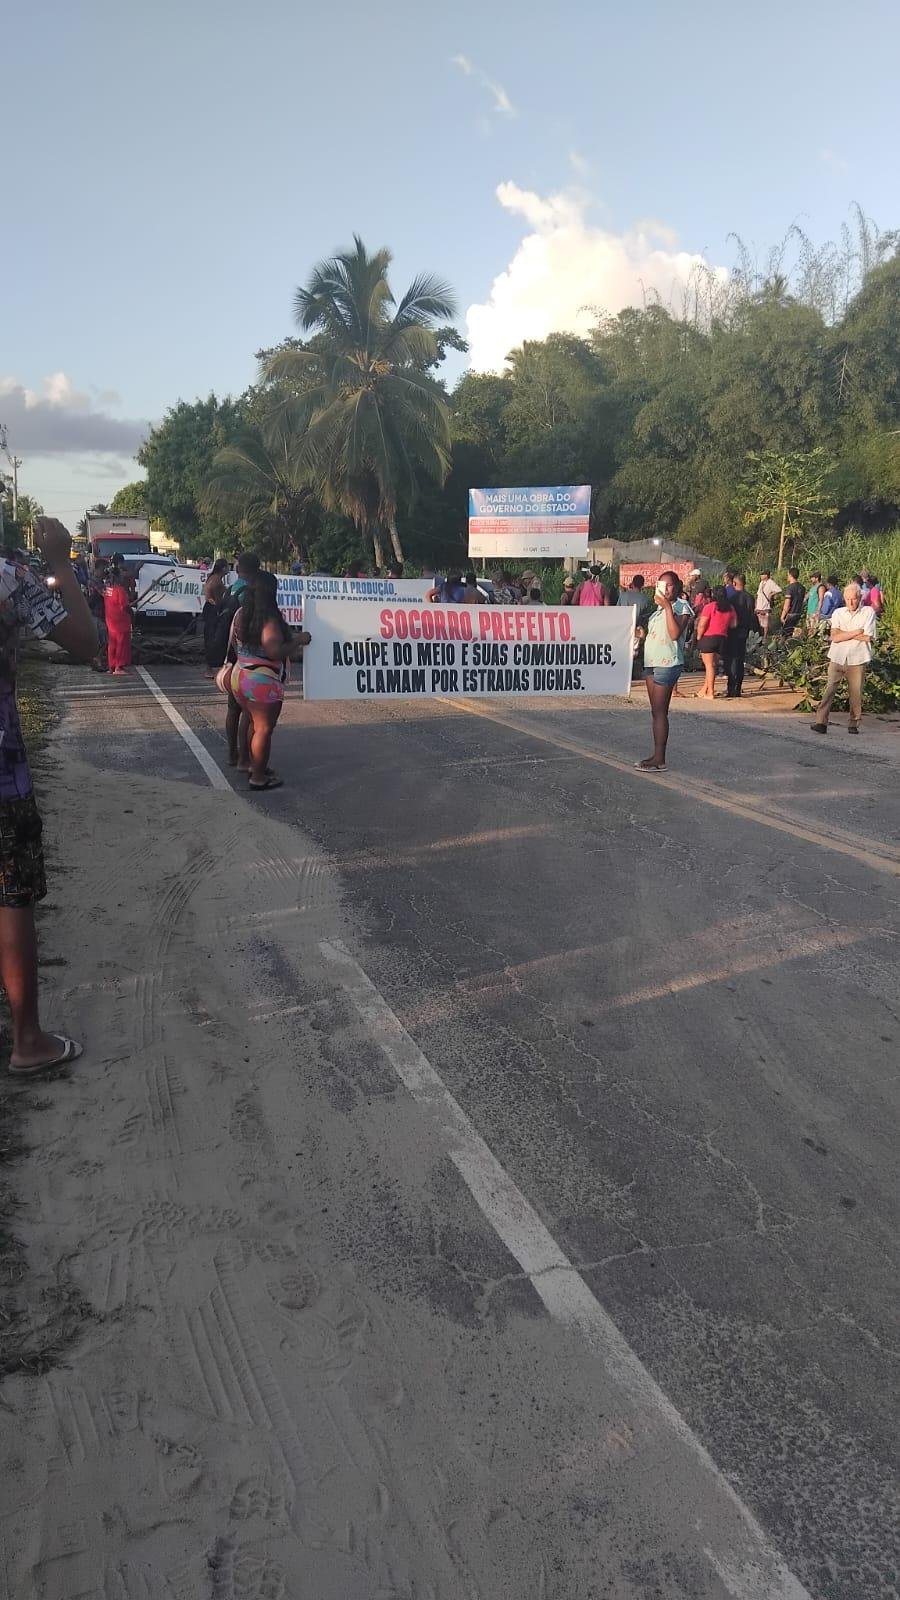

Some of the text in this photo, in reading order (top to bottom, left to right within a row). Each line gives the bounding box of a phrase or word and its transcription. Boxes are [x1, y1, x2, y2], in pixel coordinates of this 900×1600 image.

[479, 503, 577, 513] GOVERNO DO ESTADO
[485, 493, 571, 503] MAIS UMA OBRA DO
[277, 578, 398, 596] COMO ESCOAR A PRODUÇÃO,
[478, 611, 577, 642] PREFEITO.
[332, 637, 617, 667] ACUÍPE DO MEIO E SUAS COMUNIDADES,
[356, 668, 585, 694] CLAMAM POR ESTRADAS DIGNAS.
